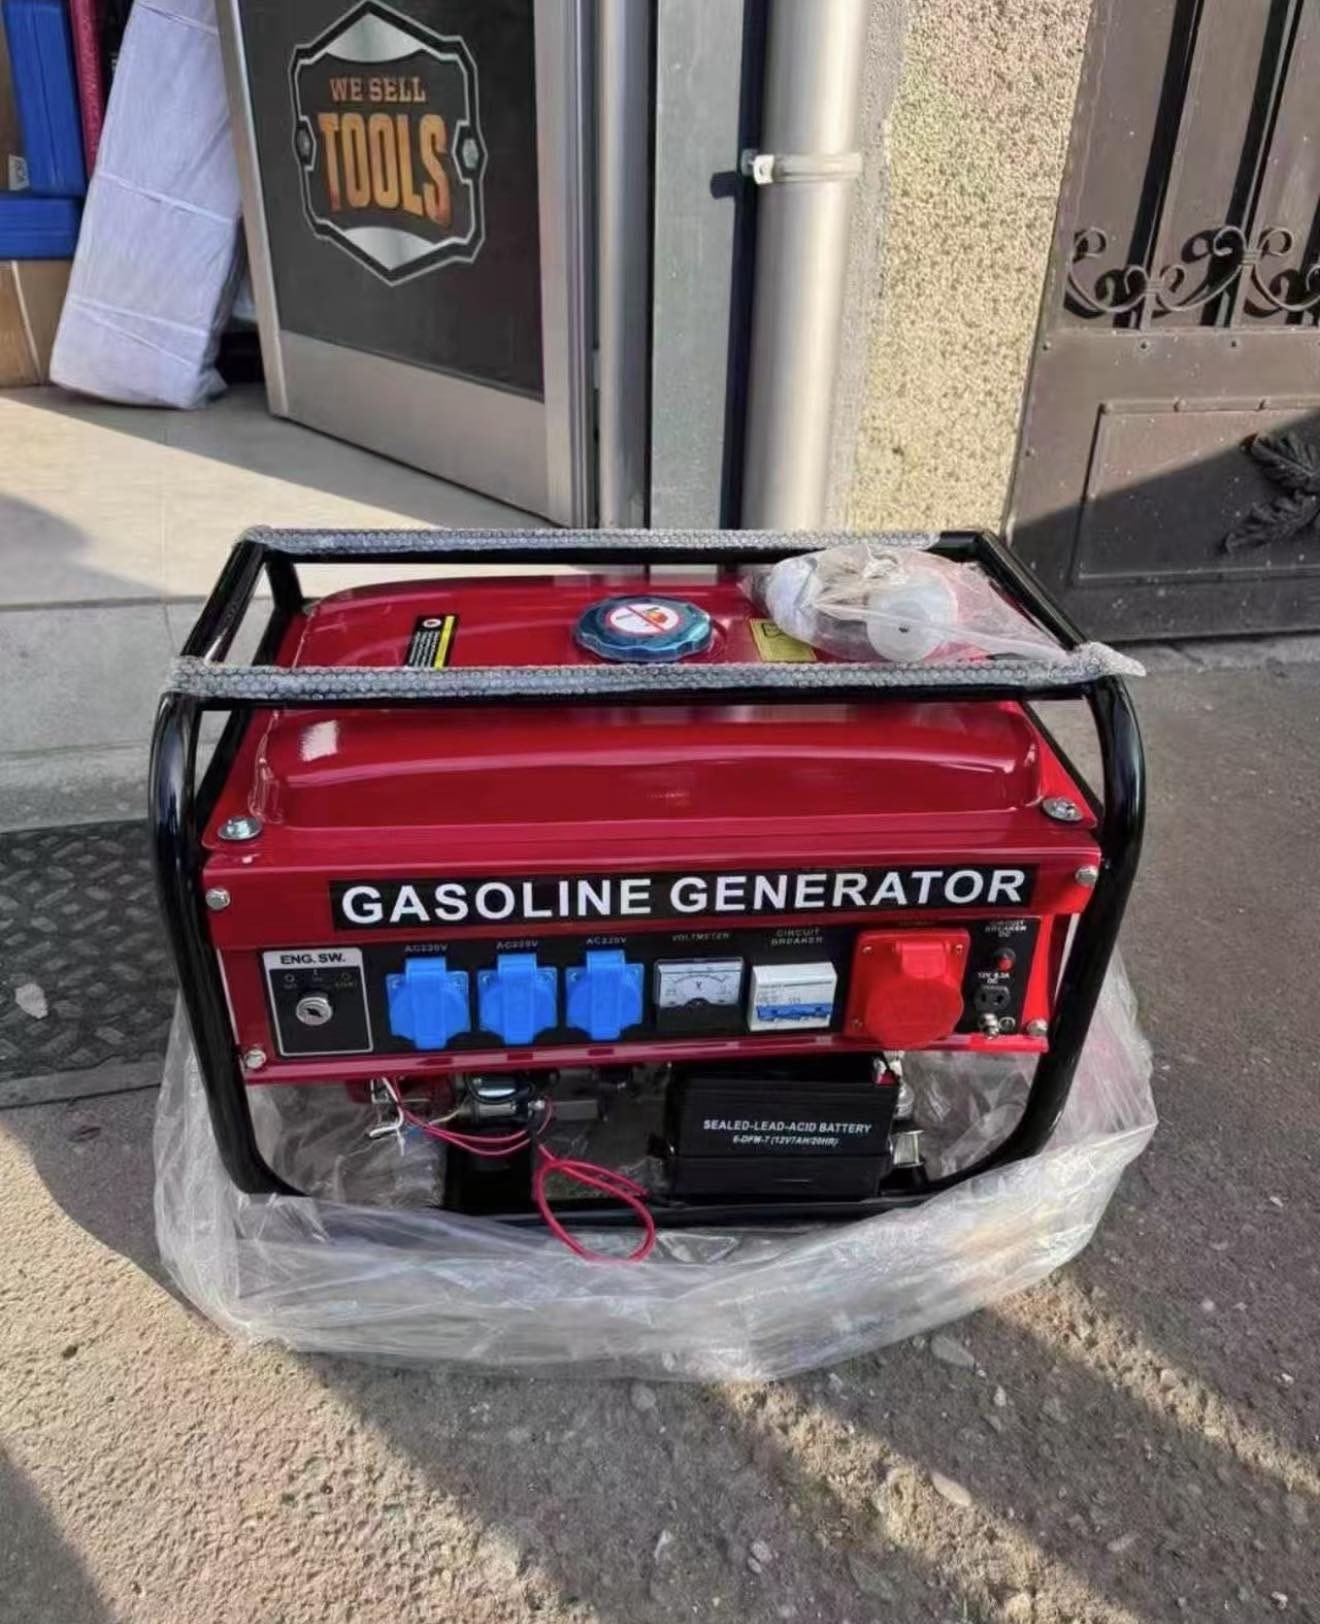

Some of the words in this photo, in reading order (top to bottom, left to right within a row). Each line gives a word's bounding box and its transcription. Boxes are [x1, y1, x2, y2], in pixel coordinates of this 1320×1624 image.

[329, 77, 363, 102] WE
[369, 77, 426, 103] SELL
[317, 112, 452, 229] TOOLS
[341, 877, 652, 924] GASOLINE
[669, 869, 1026, 914] GENERATOR
[818, 1123, 872, 1134] BATTERY
